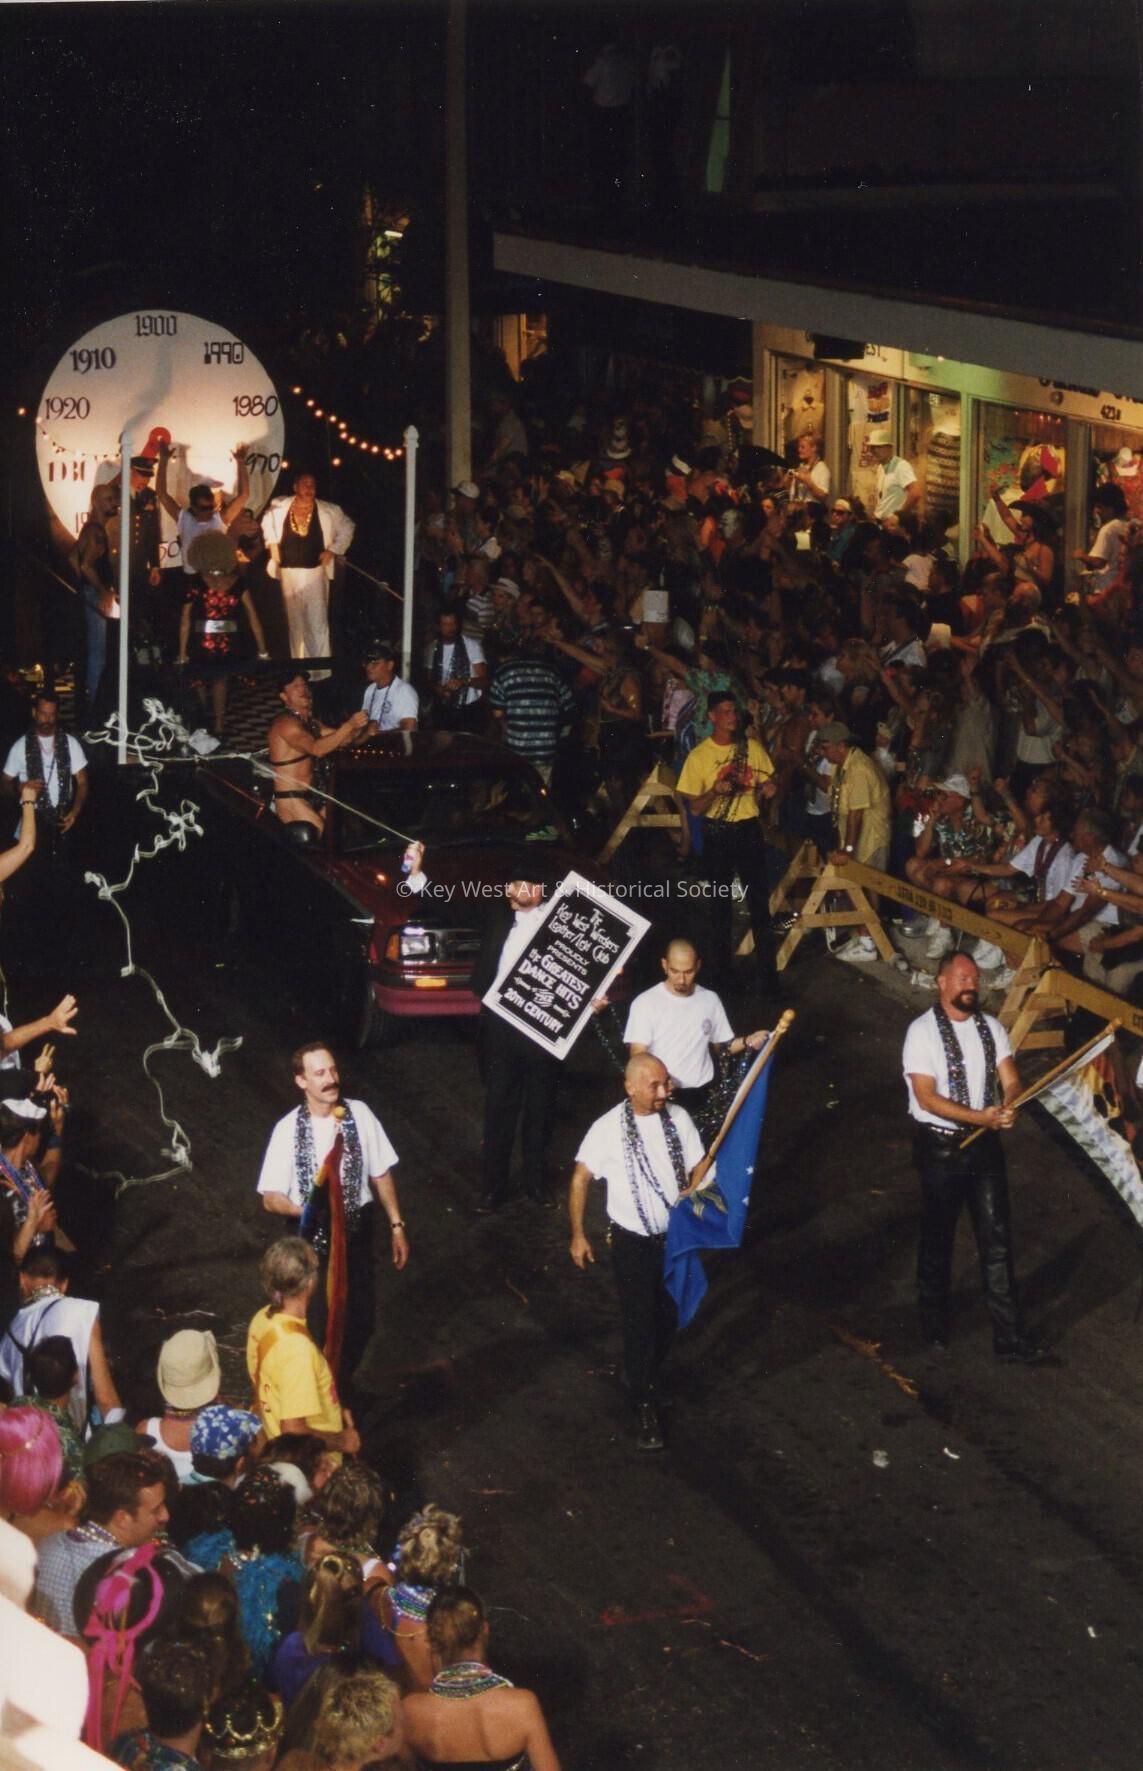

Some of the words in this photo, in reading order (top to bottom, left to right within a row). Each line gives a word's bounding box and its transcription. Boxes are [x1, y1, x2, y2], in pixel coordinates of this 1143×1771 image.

[135, 315, 177, 336] 1900
[70, 347, 117, 374] 1910
[204, 342, 244, 364] 1990
[45, 396, 90, 420] 1920
[233, 395, 279, 417] 1980
[245, 453, 280, 475] 970
[572, 914, 592, 932] West
[547, 945, 587, 975] PRESENTS
[554, 940, 589, 965] PROUDLY
[592, 945, 609, 964] Club
[552, 984, 582, 1009] HITS
[524, 1002, 563, 1033] CENTURY
